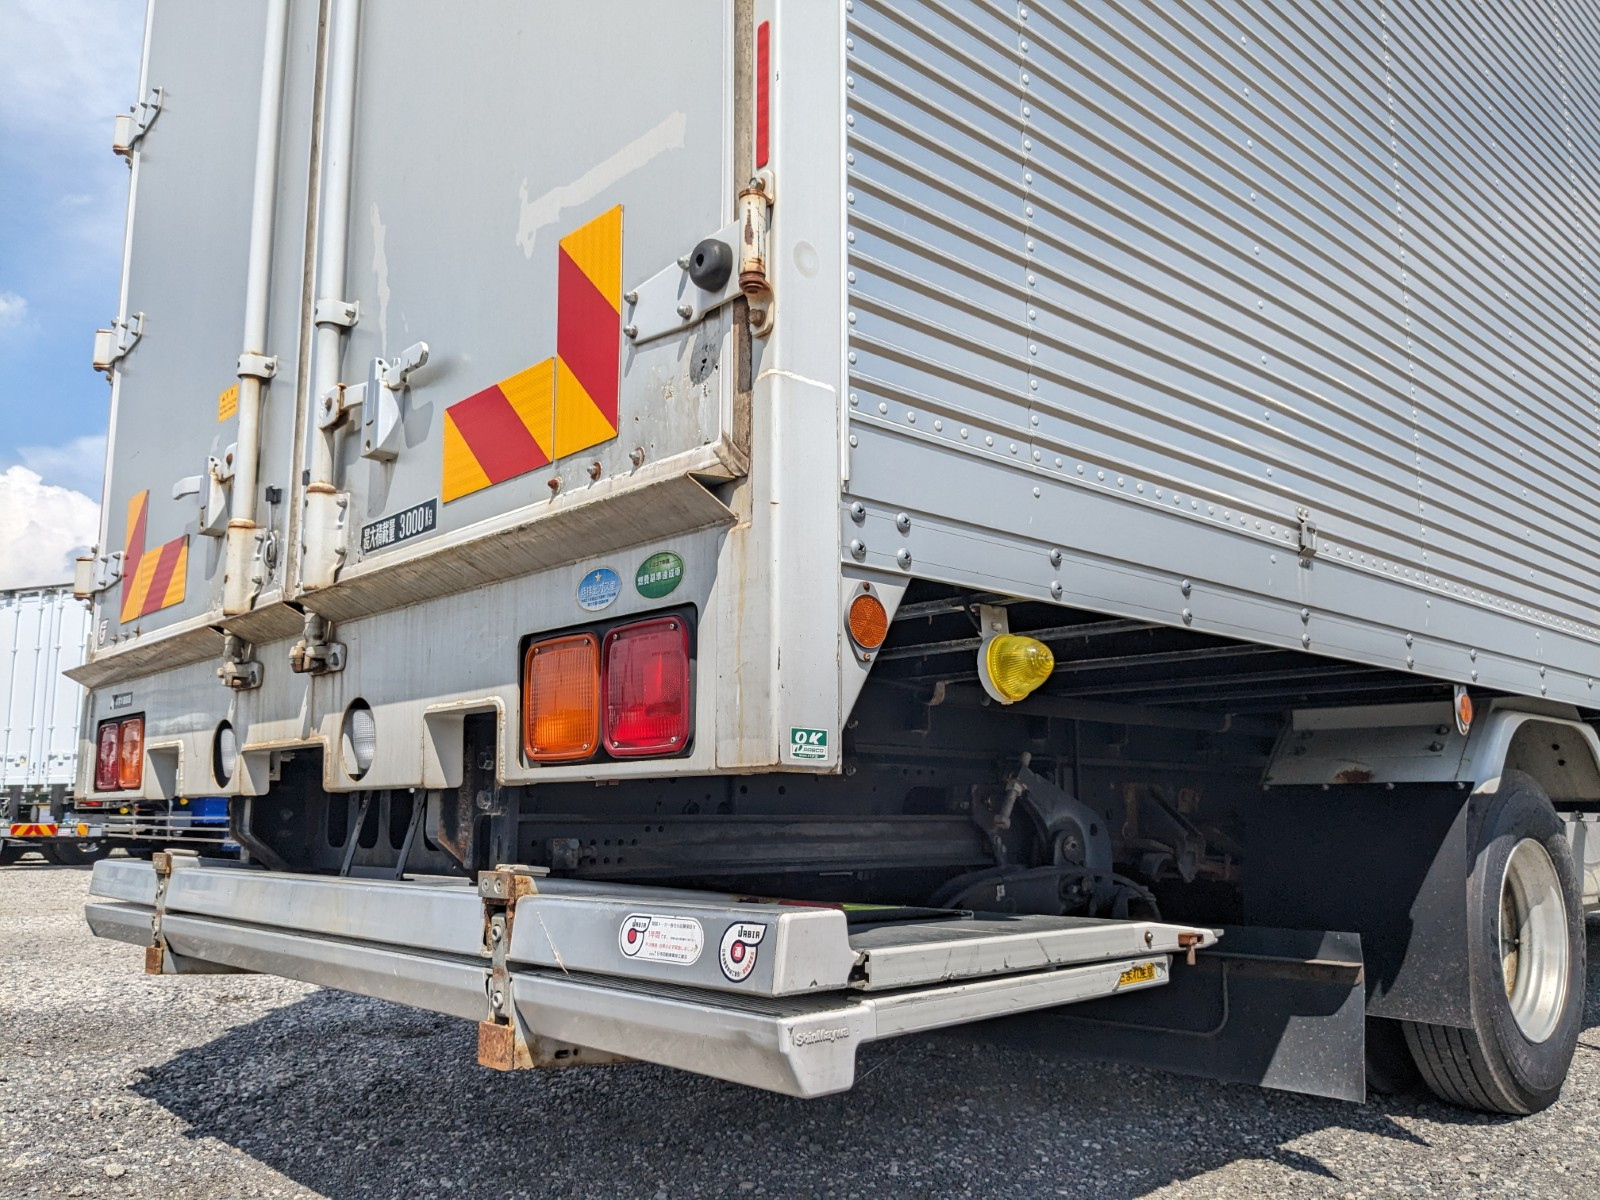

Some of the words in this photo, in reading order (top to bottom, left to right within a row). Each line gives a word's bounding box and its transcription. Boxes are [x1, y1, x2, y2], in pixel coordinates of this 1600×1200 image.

[363, 518, 396, 550] 最大積載量
[795, 731, 823, 745] OK
[738, 925, 760, 939] JABIA
